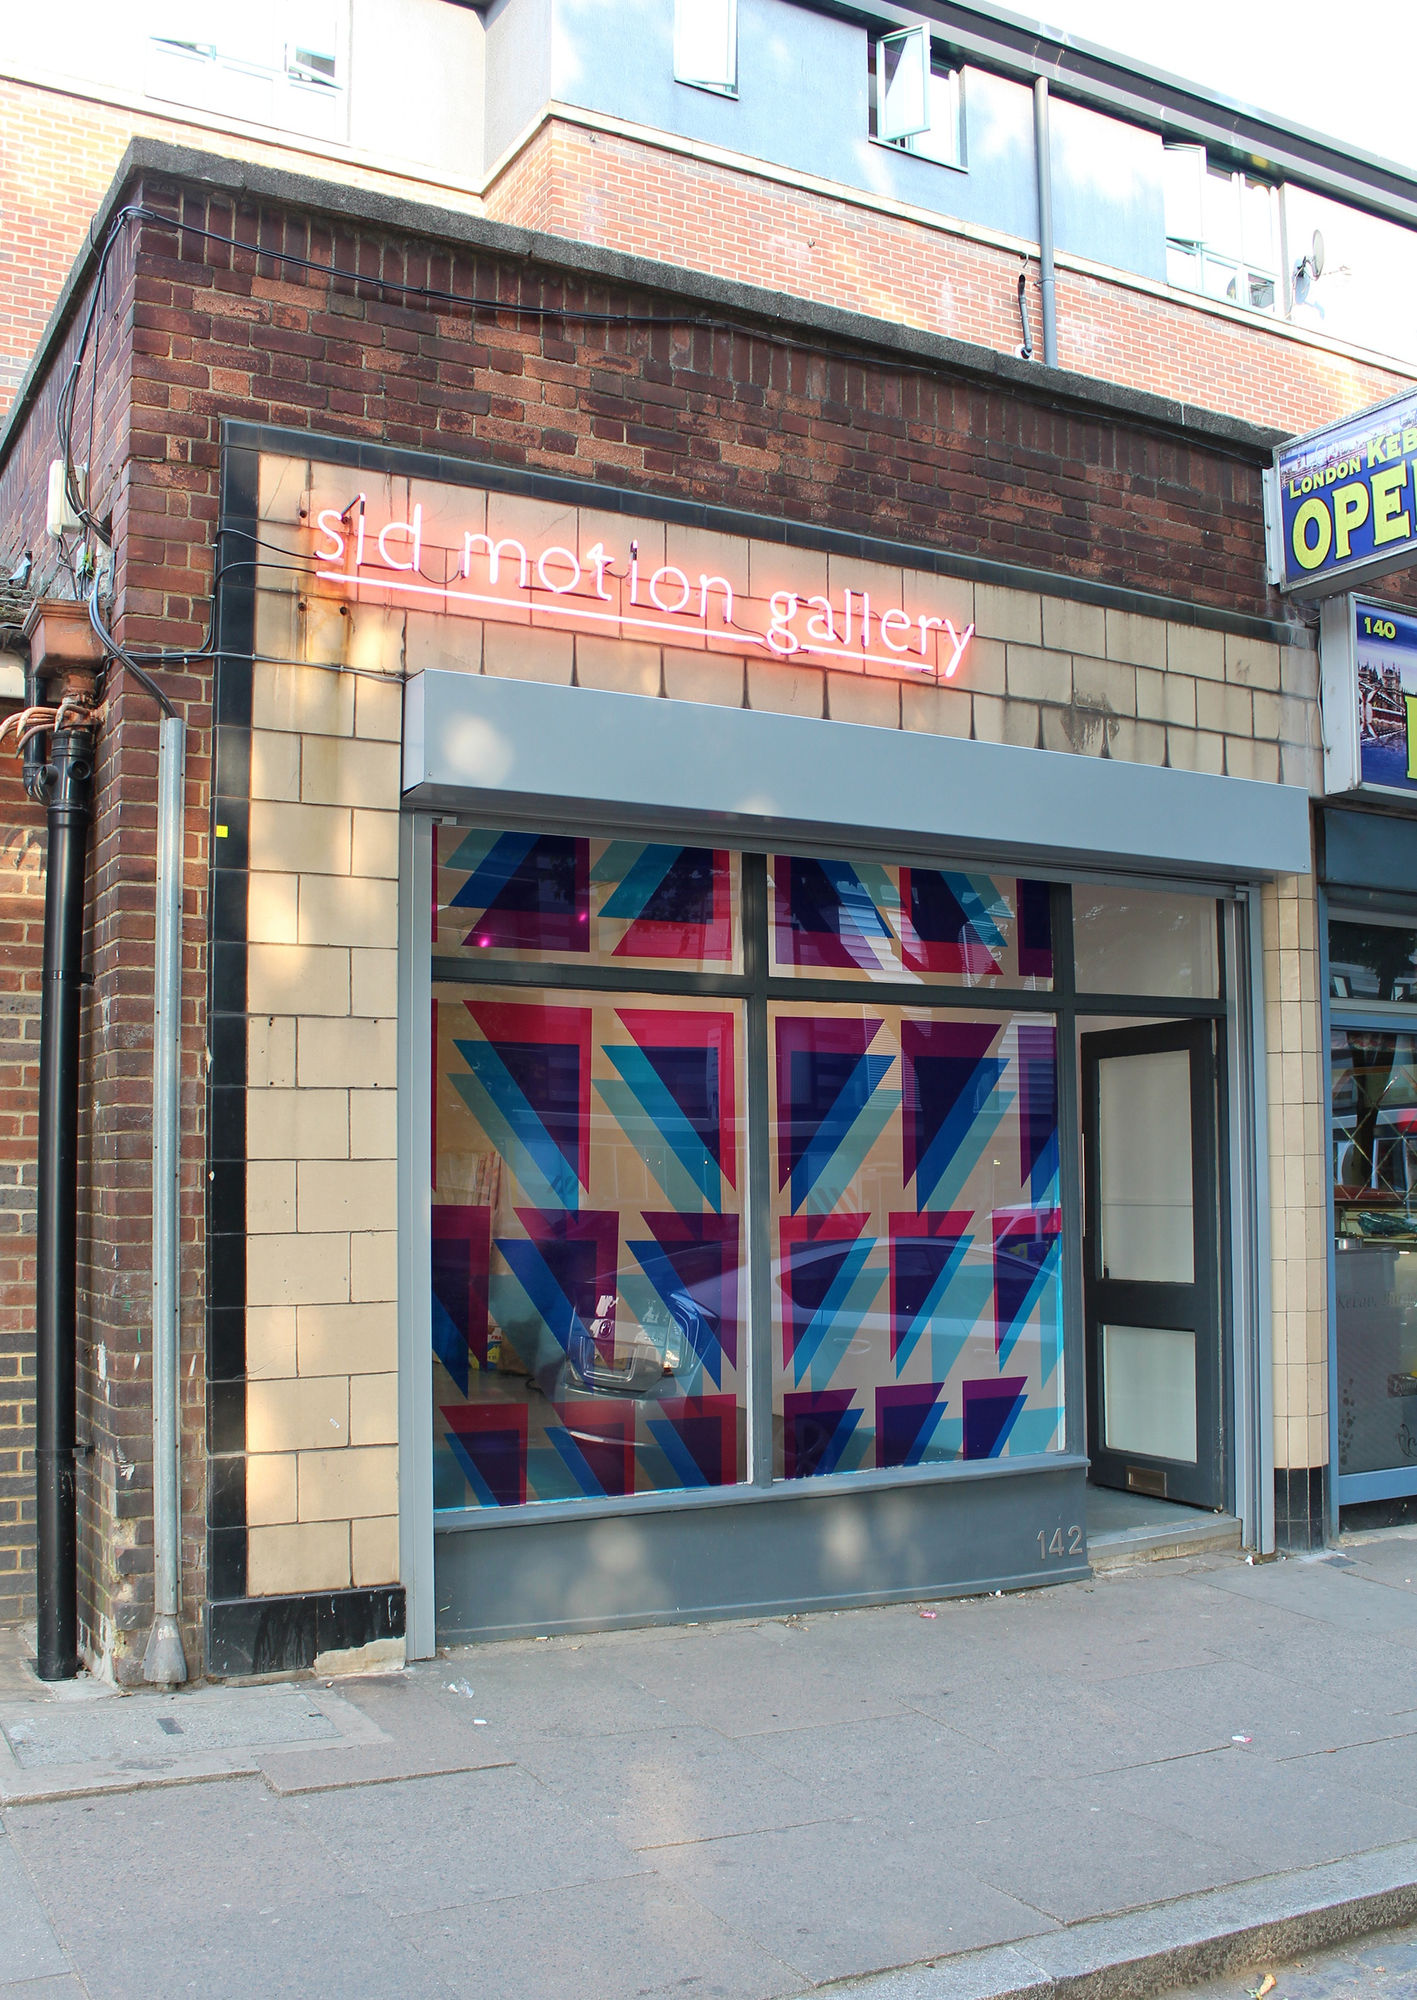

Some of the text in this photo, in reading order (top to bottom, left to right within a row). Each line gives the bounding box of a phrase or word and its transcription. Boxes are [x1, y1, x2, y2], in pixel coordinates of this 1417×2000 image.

[1289, 457, 1361, 498] LONDON
[1292, 459, 1417, 570] OPE
[315, 492, 974, 677] sid motion gallery
[1364, 616, 1396, 639] 140
[1037, 1525, 1083, 1560] 142
